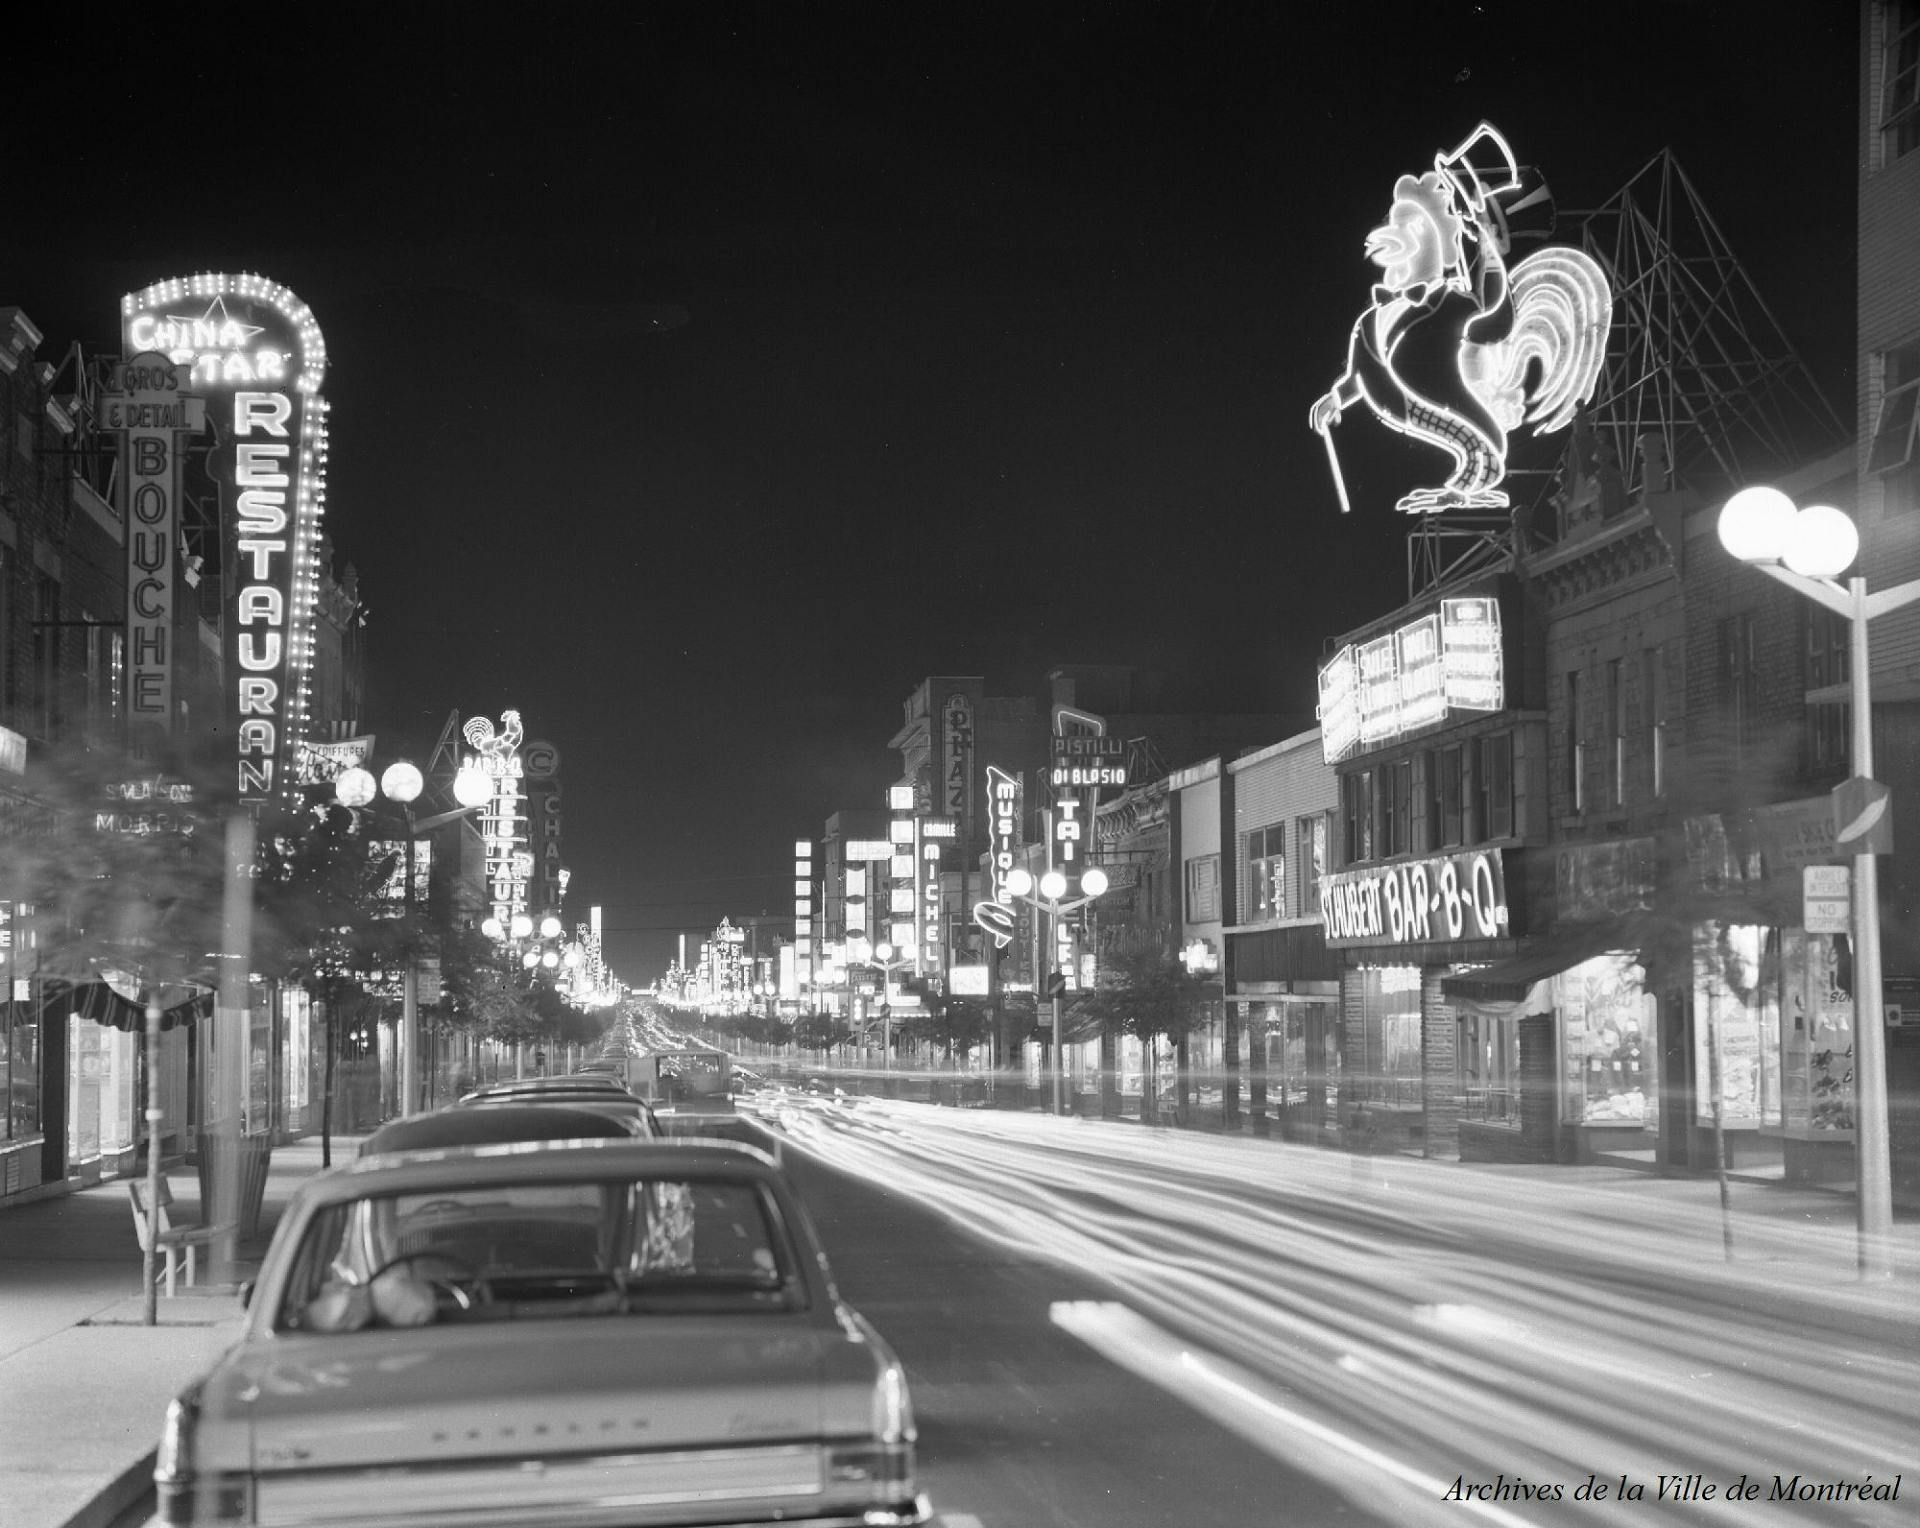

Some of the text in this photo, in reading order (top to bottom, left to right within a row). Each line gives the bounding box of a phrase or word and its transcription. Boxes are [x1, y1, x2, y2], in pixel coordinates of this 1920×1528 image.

[131, 316, 247, 350] CHINA
[122, 365, 179, 393] GROS
[109, 401, 191, 429] & DETAIL
[1053, 769, 1126, 785] DI BLASIO
[996, 783, 1015, 904] MUSIQUE
[923, 843, 940, 962] MICHEL
[1817, 903, 1837, 916] NO
